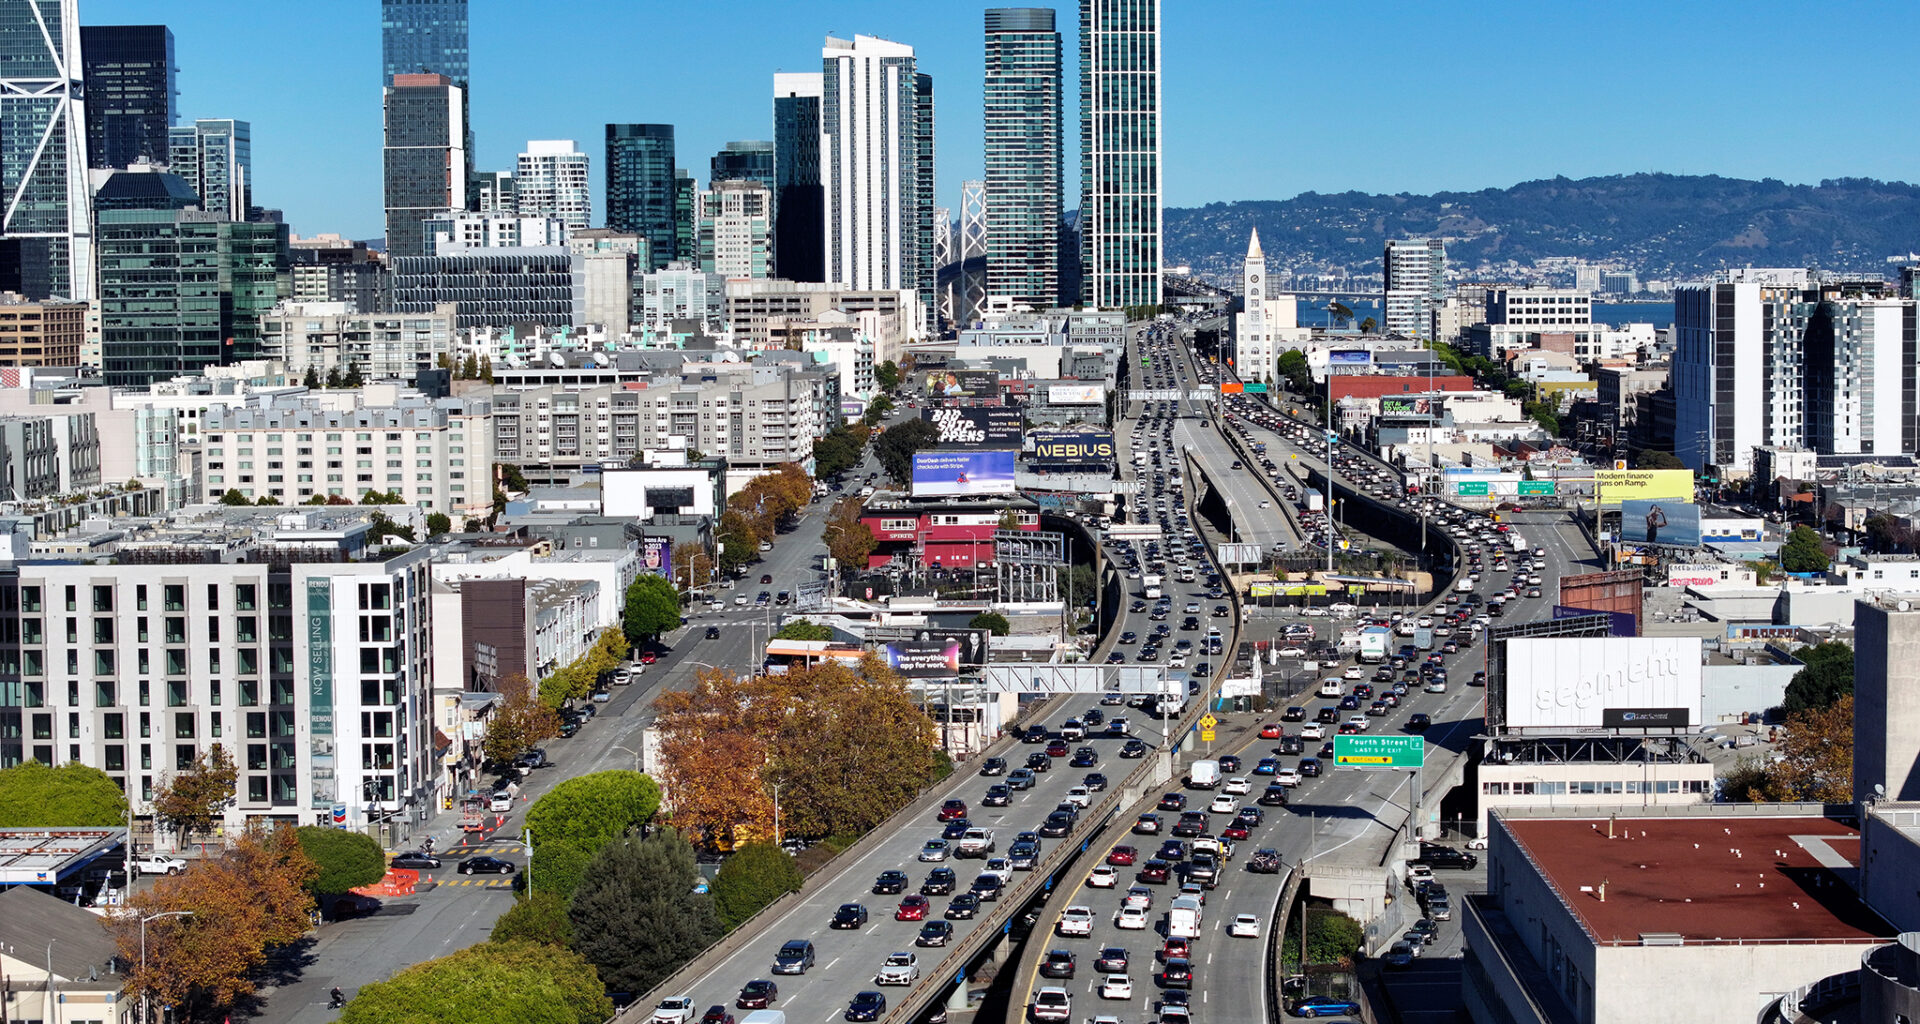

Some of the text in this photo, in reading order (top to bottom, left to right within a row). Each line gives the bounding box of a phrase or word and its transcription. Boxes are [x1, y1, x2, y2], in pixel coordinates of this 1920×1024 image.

[931, 409, 962, 422] BAD
[1037, 444, 1112, 457] NEBIUS
[312, 618, 323, 695] NOW SELLING
[1535, 649, 1679, 712] segment
